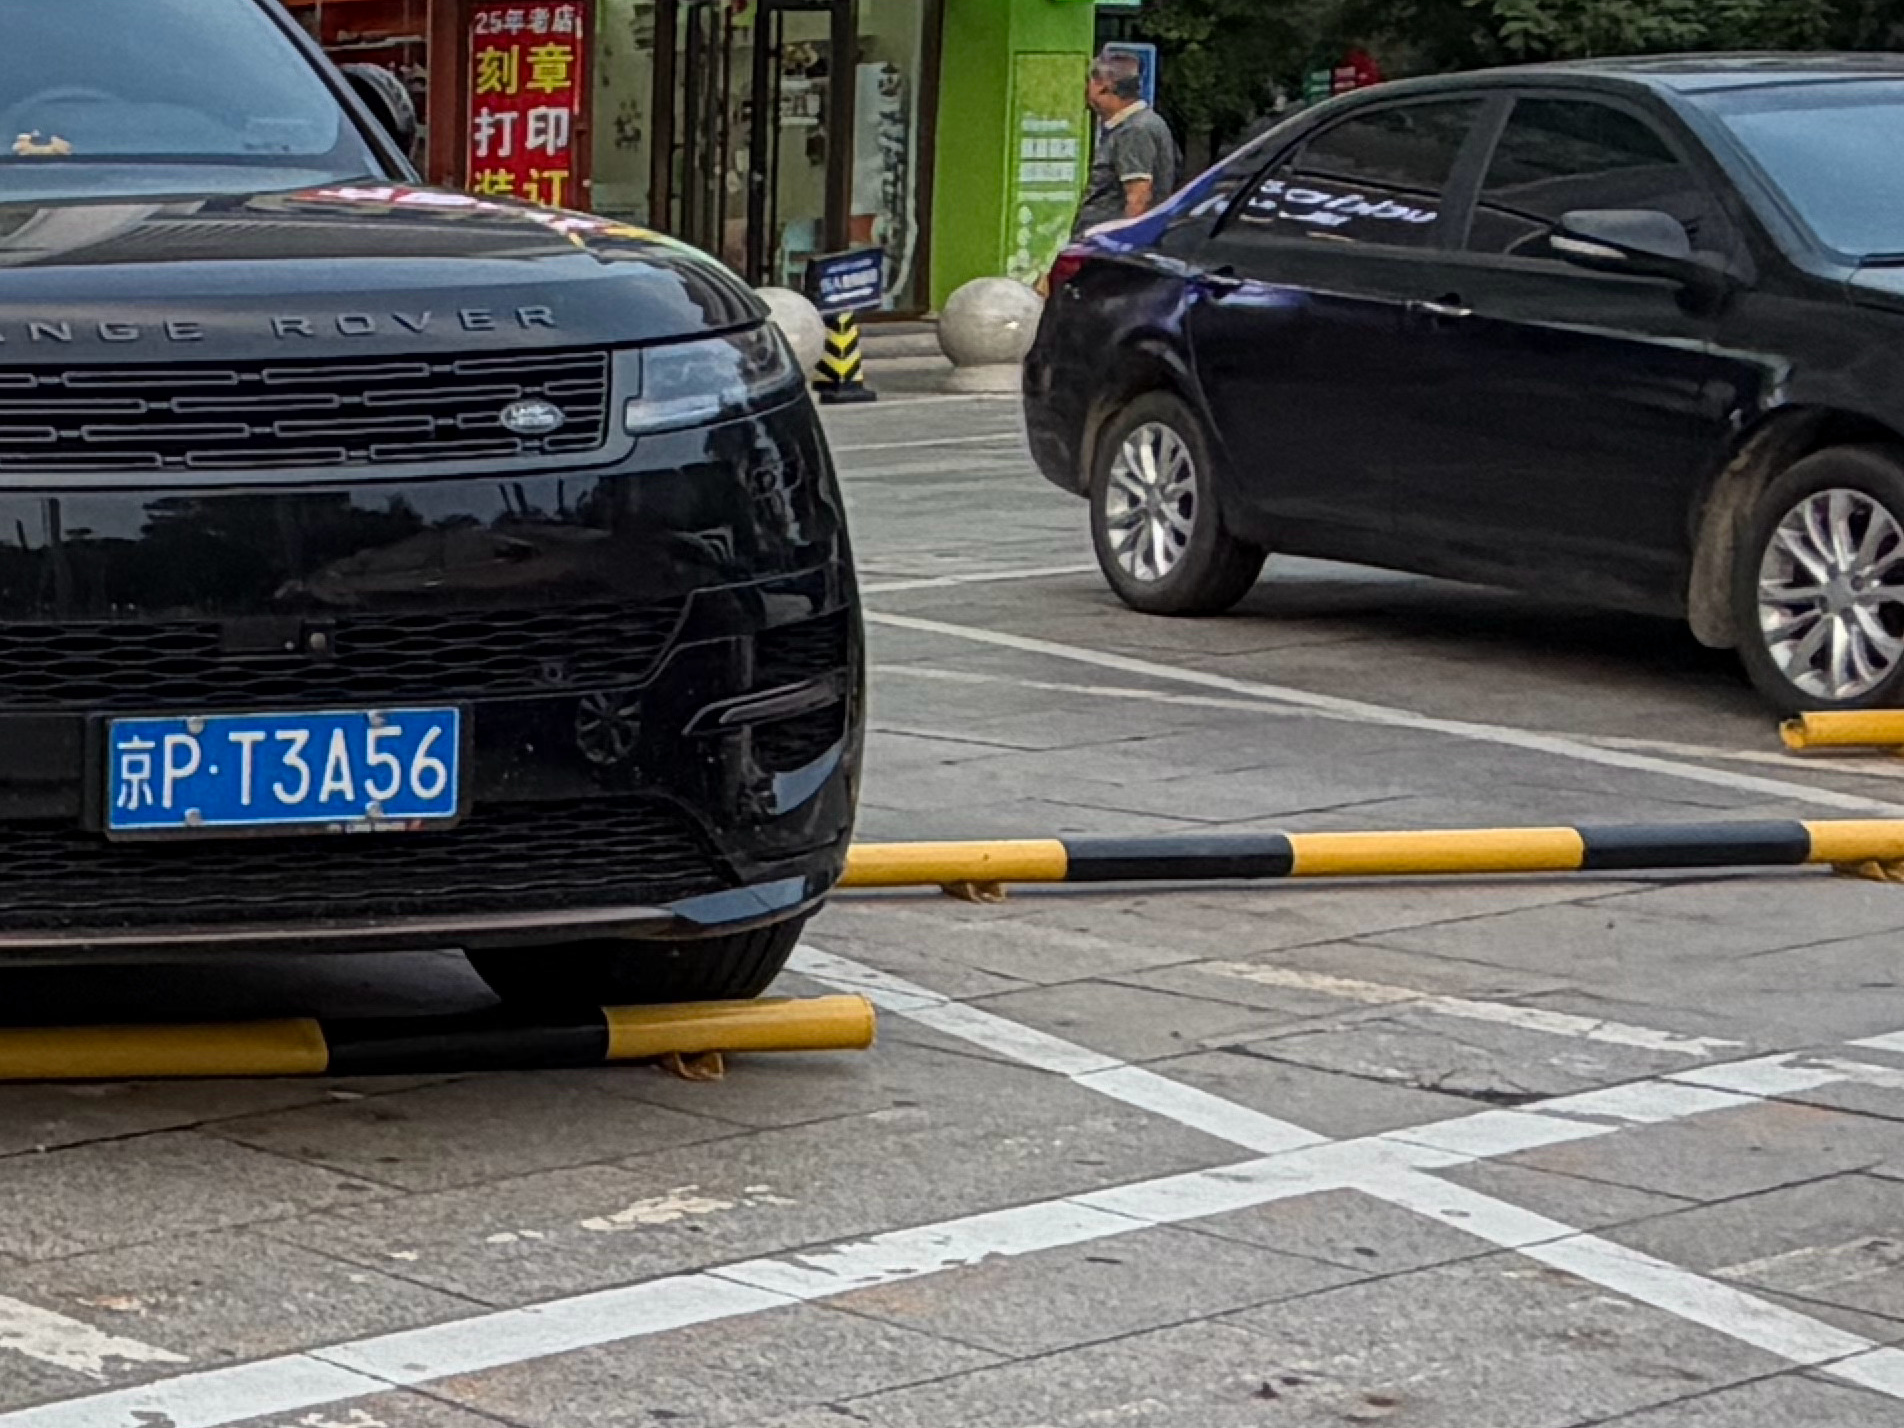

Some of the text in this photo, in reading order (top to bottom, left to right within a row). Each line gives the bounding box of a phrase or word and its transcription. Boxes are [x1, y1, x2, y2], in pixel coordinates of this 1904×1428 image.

[475, 4, 576, 35] 25年老店
[474, 42, 573, 95] 刻章
[473, 105, 570, 158] 打印
[271, 305, 557, 339] ROVER
